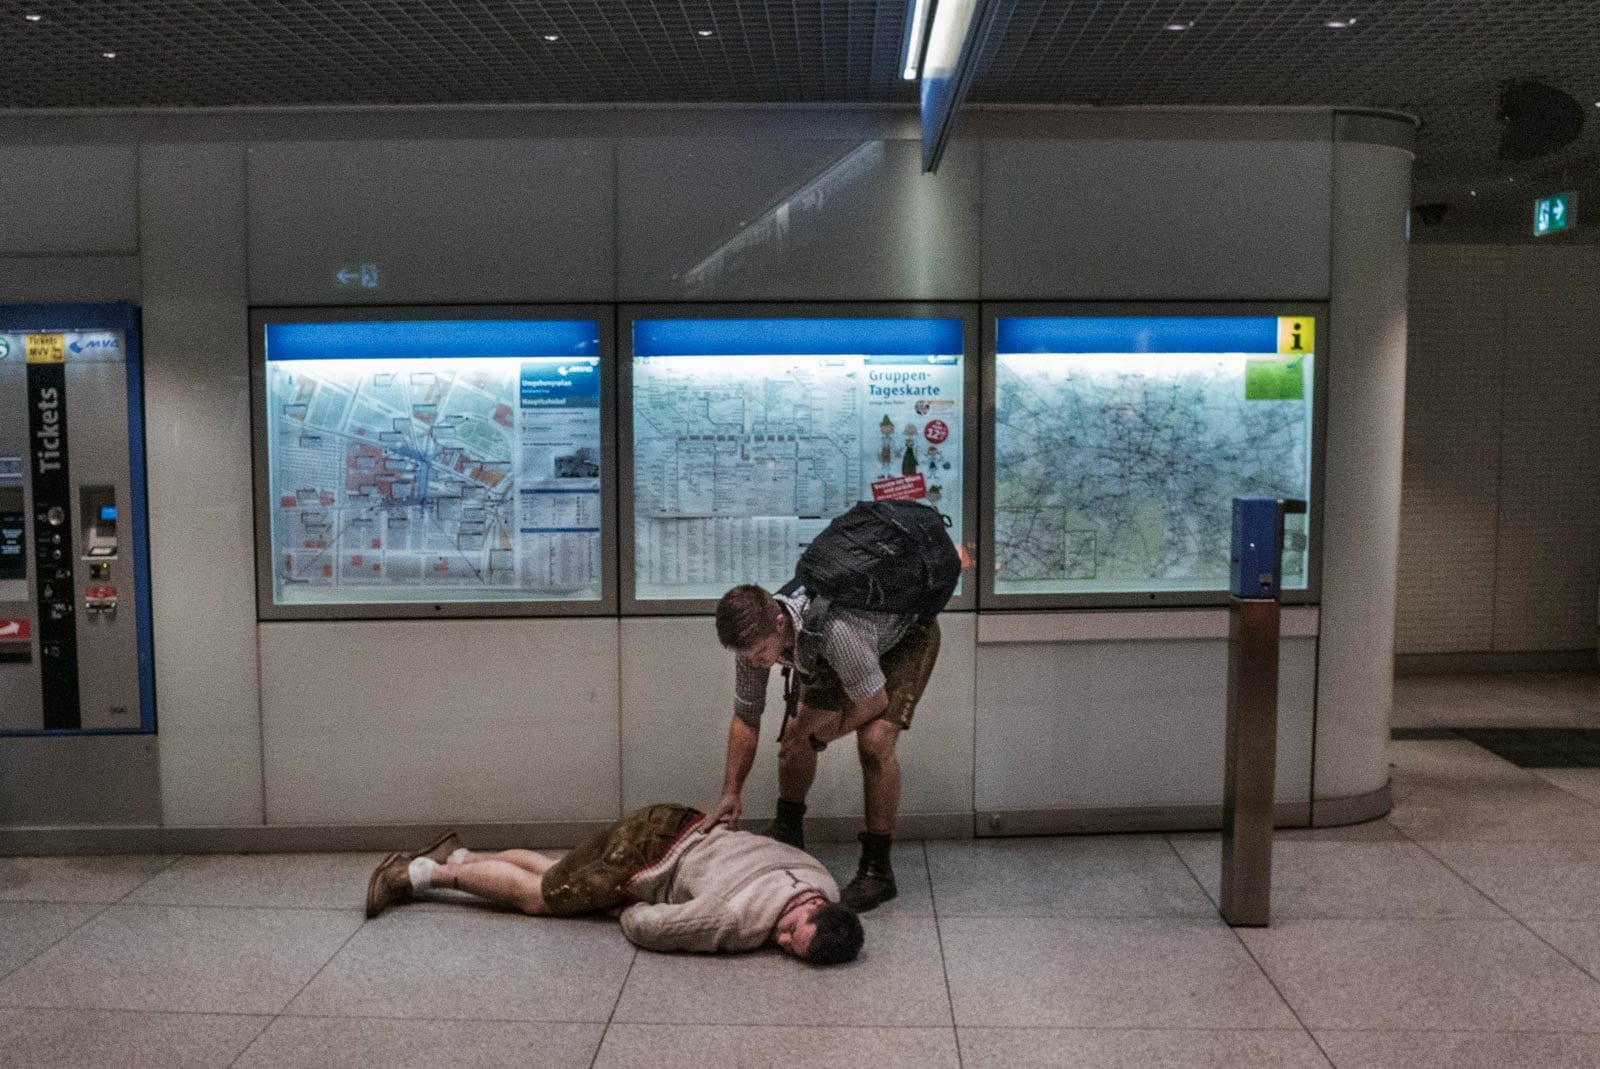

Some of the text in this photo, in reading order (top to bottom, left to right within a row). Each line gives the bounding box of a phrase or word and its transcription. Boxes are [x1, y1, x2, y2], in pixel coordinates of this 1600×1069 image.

[29, 335, 58, 344] Tickets
[1291, 323, 1303, 350] i
[869, 370, 931, 383] Gruppen-
[869, 384, 940, 398] Tageskarte
[38, 387, 60, 474] Tickets
